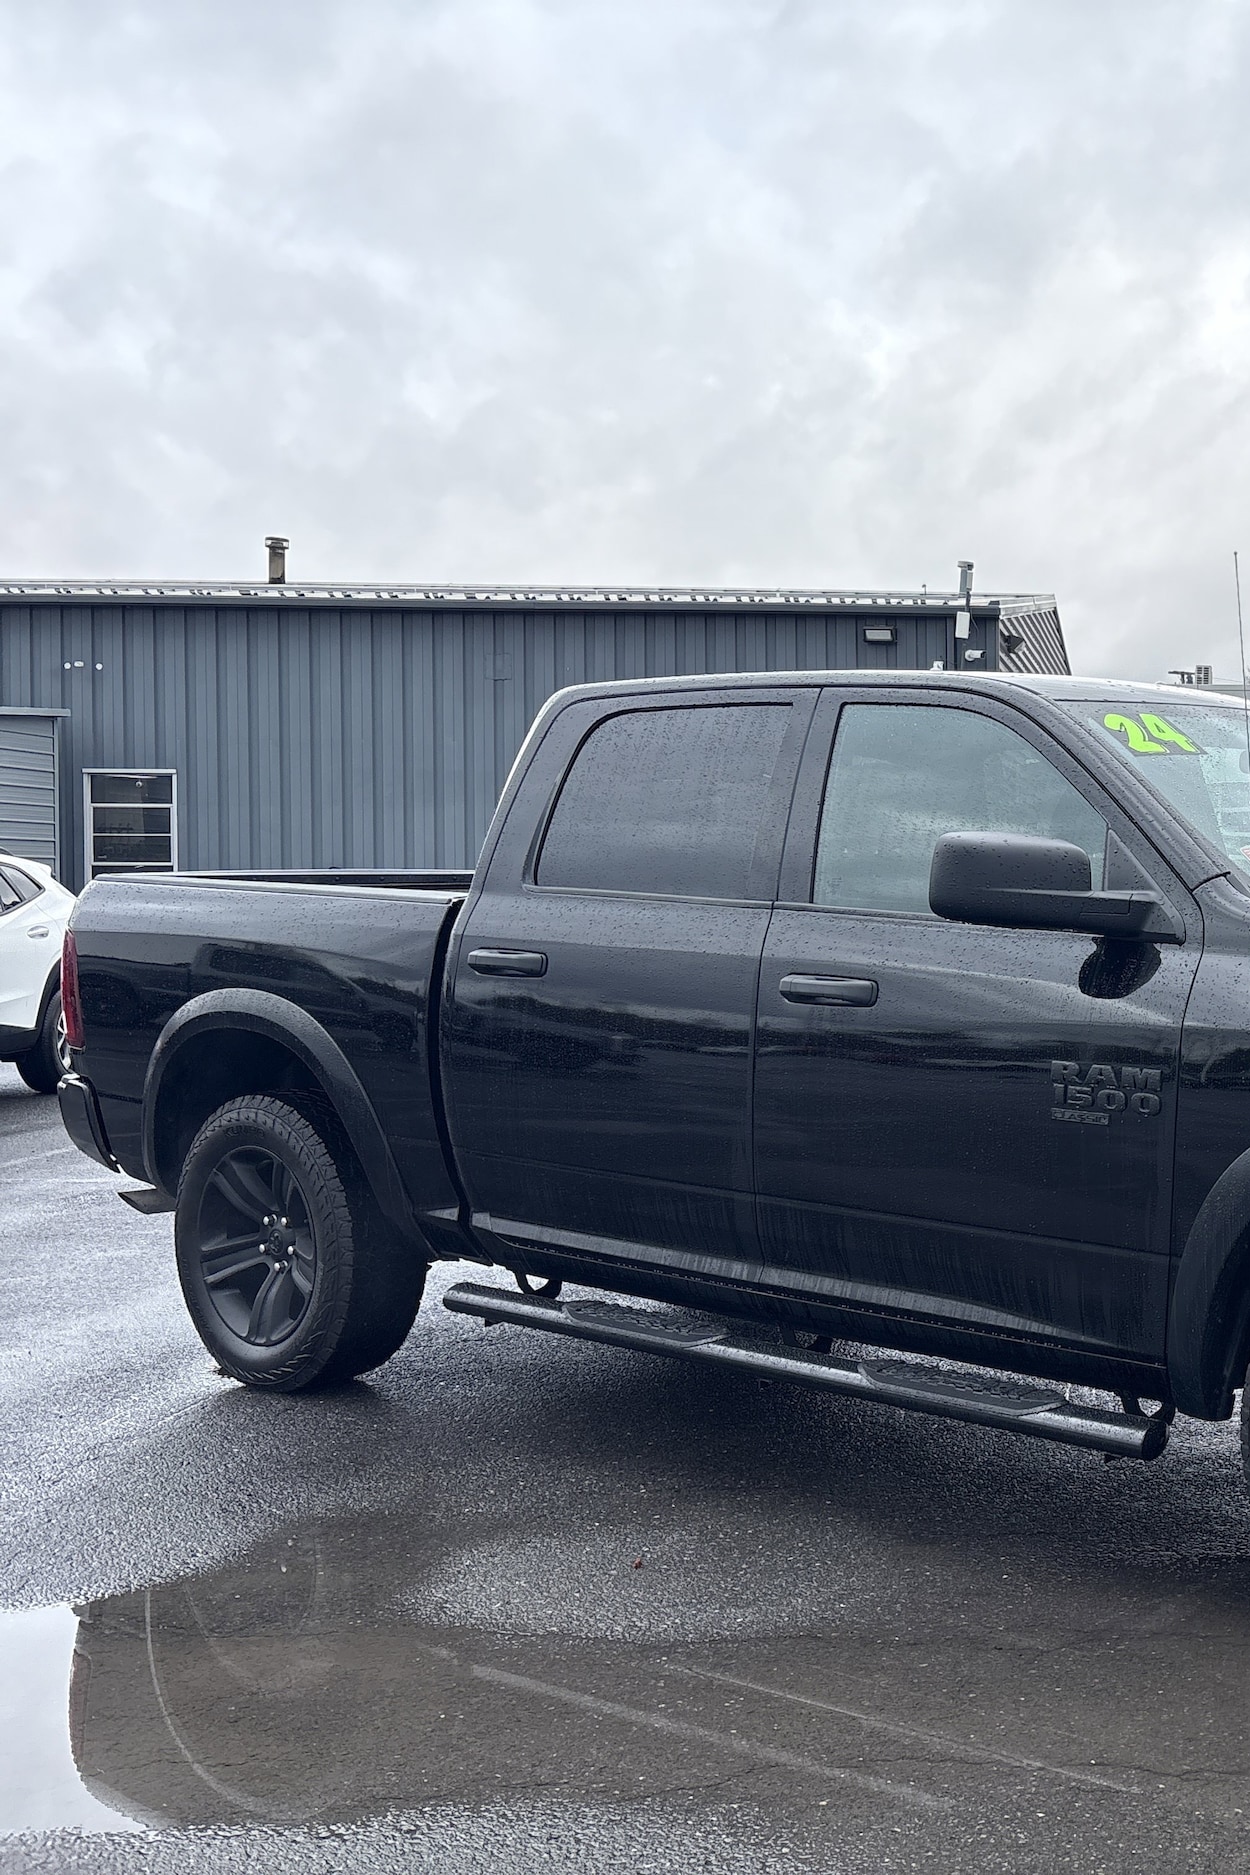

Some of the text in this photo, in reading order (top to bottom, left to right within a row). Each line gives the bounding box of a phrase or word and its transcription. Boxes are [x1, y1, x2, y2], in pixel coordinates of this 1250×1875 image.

[1103, 713, 1201, 754] 24
[1051, 1060, 1162, 1092] RAM
[1053, 1083, 1162, 1117] 1500
